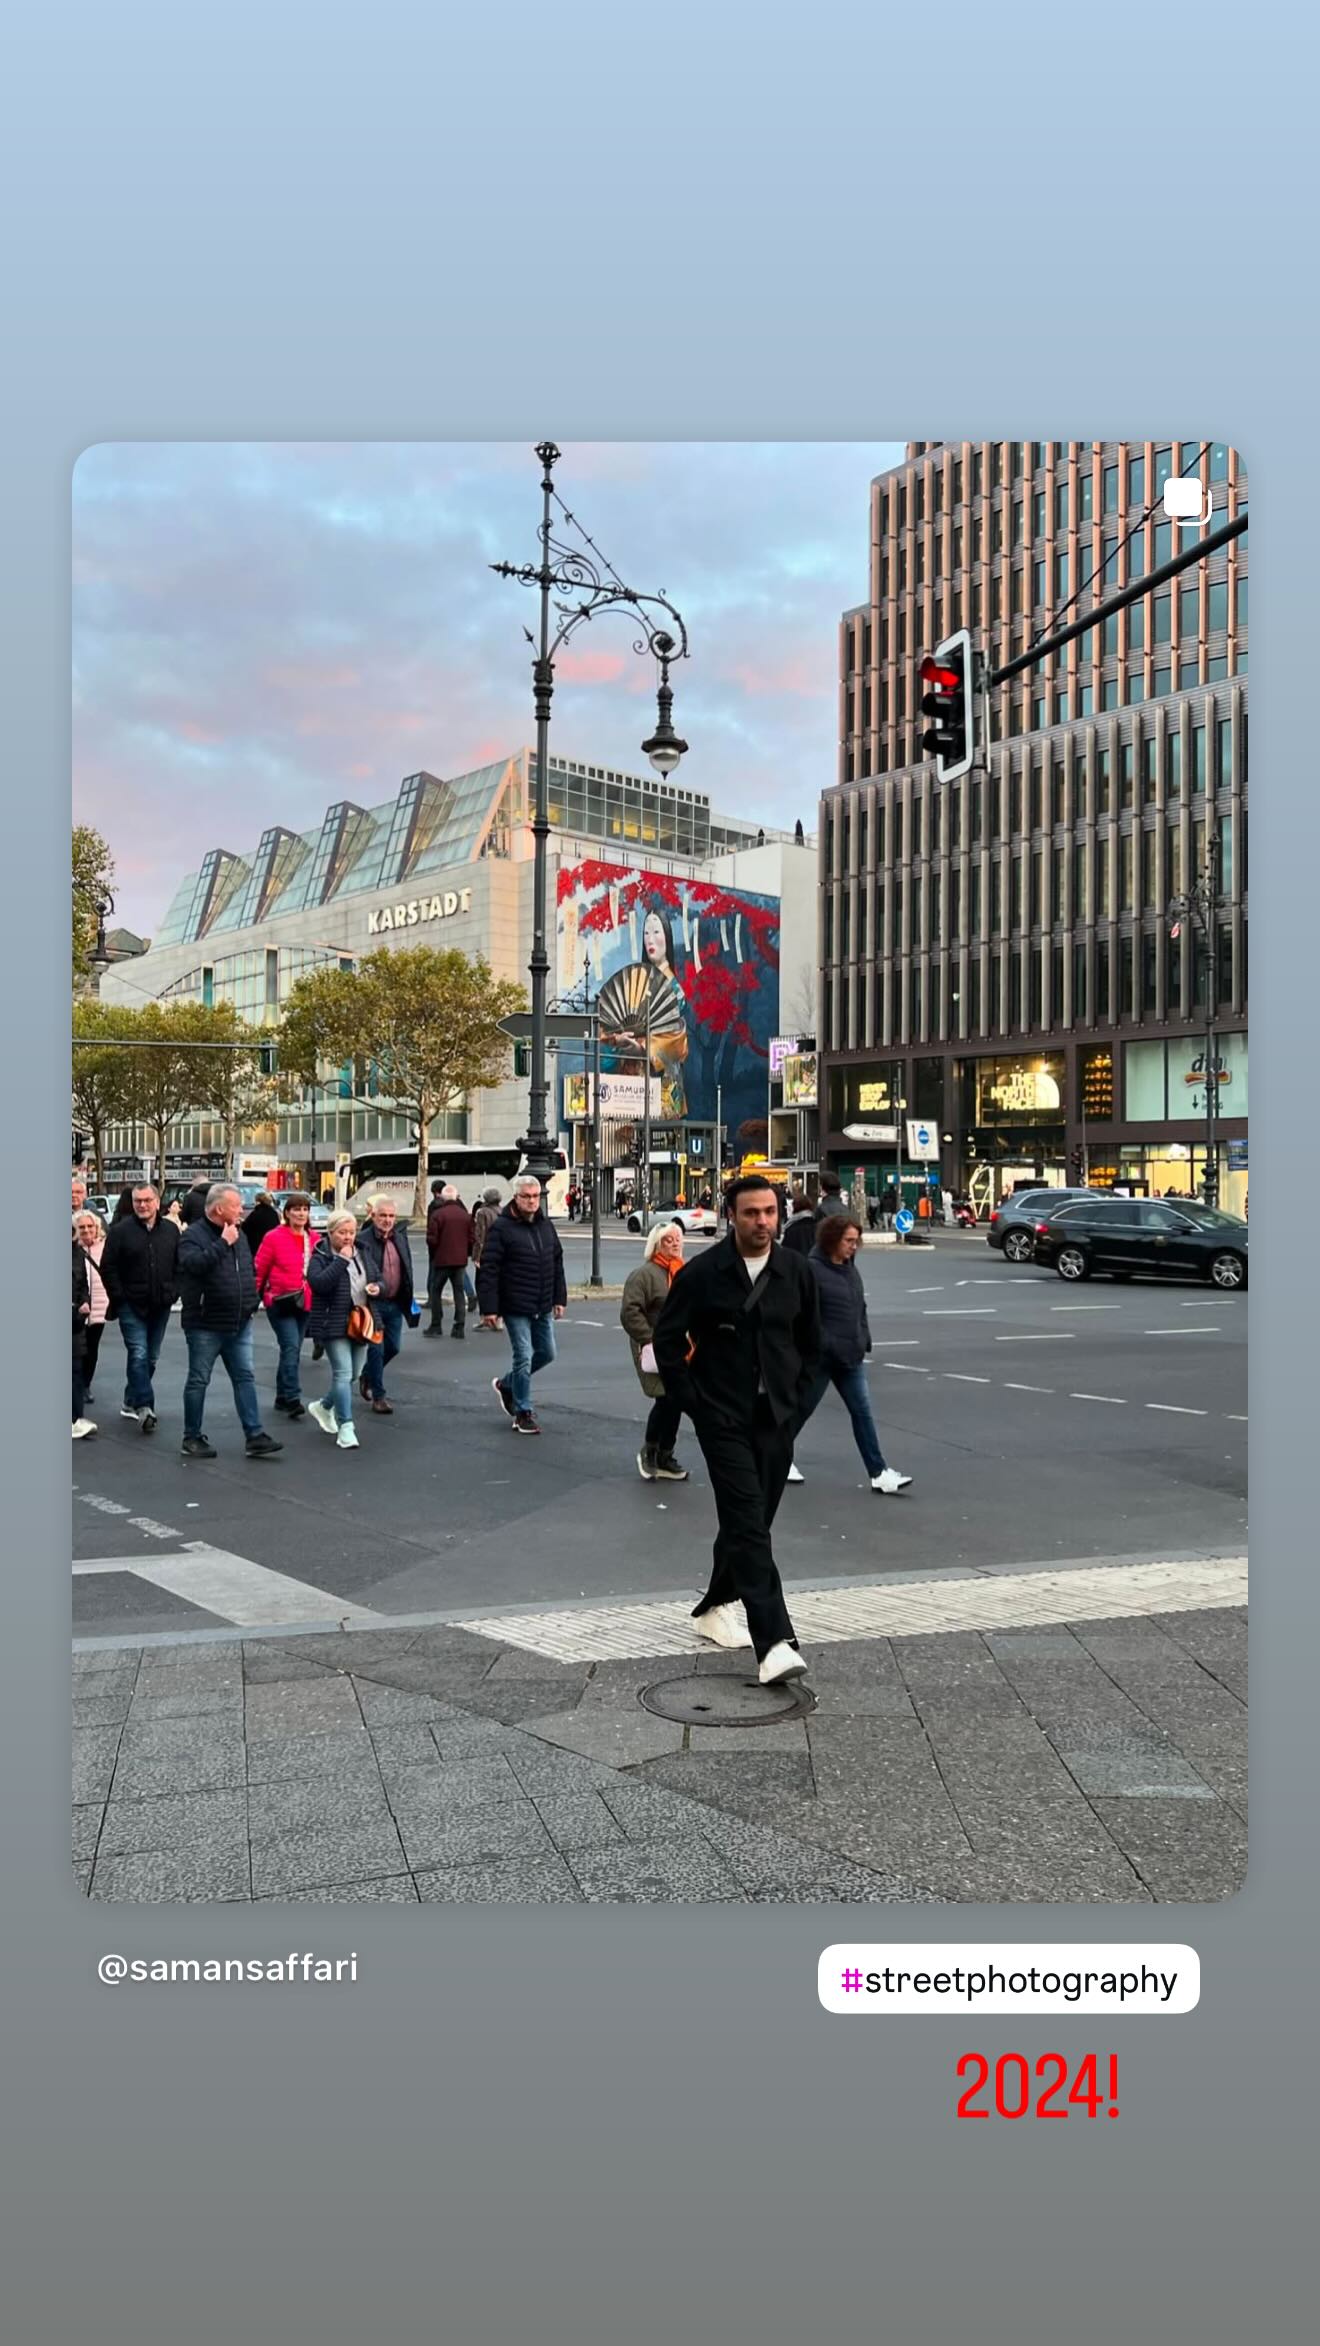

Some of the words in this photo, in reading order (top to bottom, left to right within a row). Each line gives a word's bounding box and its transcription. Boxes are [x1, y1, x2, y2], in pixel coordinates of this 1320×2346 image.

[368, 887, 472, 935] KARSTADT
[1009, 1073, 1034, 1087] THE
[990, 1086, 1034, 1100] NORTH
[1002, 1099, 1034, 1110] FACE
[692, 1139, 702, 1154] U
